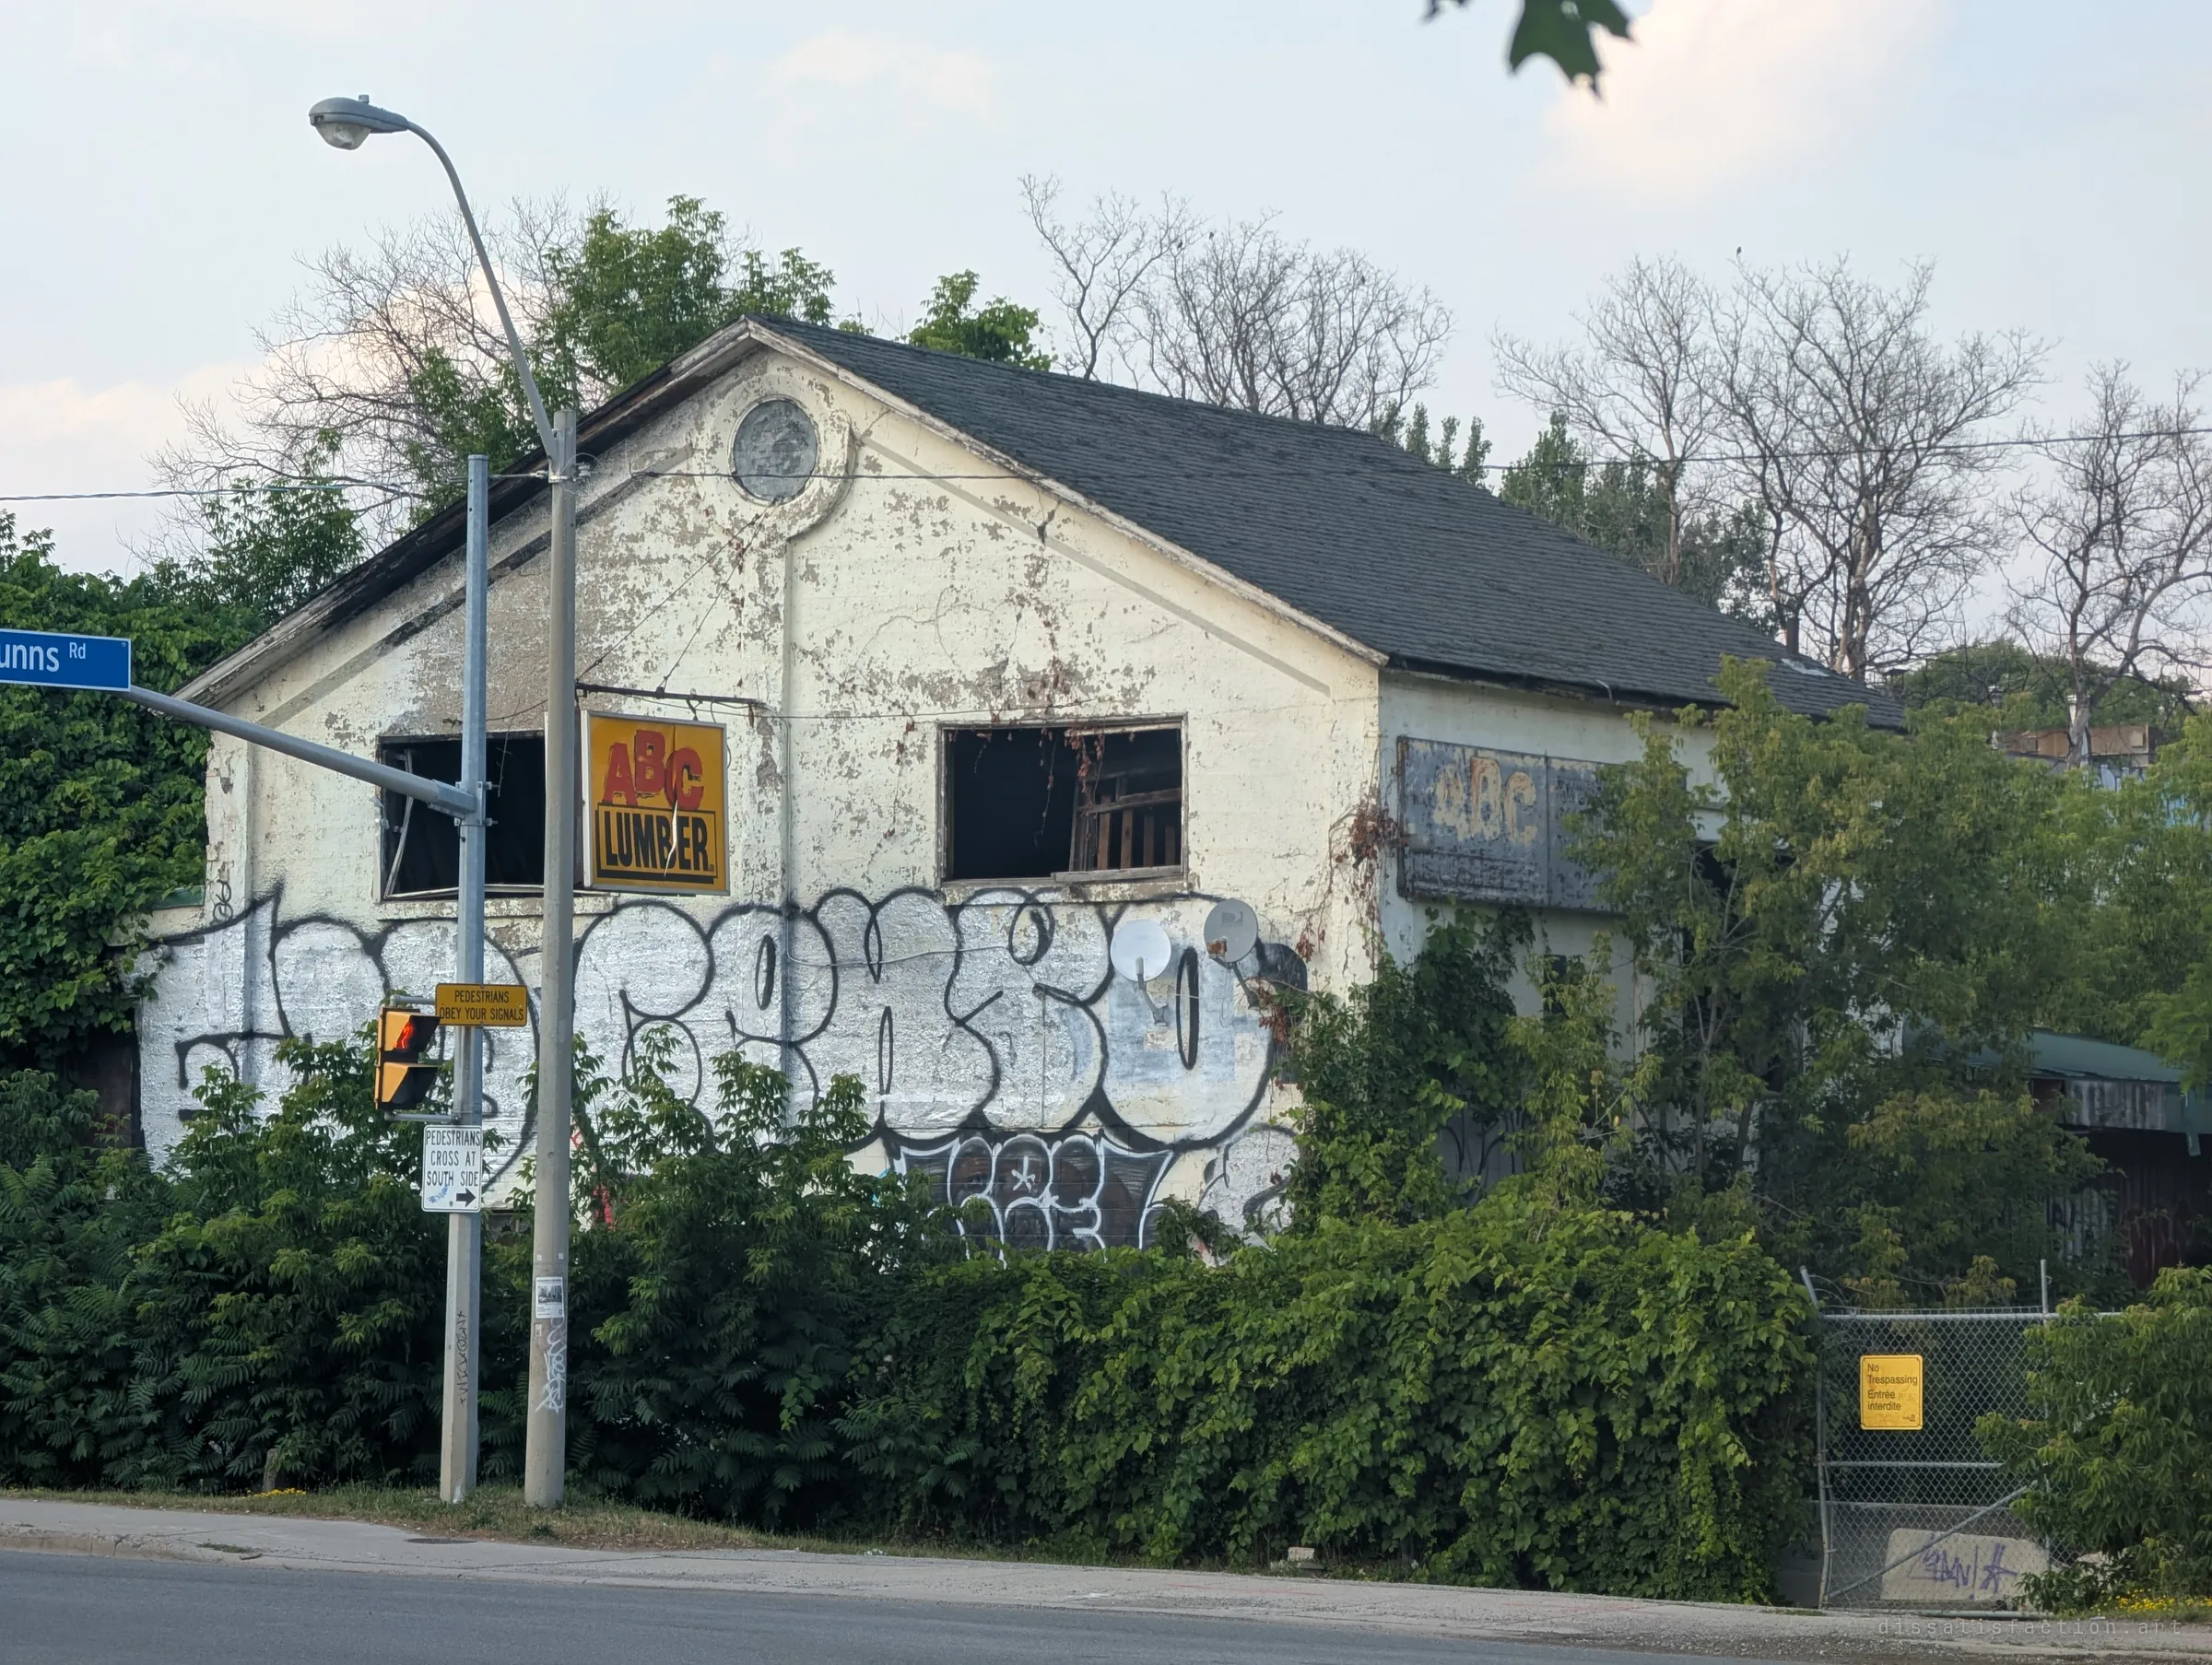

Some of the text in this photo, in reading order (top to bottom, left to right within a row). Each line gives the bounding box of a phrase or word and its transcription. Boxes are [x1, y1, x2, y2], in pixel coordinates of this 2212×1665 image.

[69, 642, 86, 659] Rd
[602, 730, 704, 811] ABC
[604, 811, 709, 872] LUMBER
[454, 990, 509, 1003] PEDESTRIANS
[440, 1006, 524, 1021] OBEY YOUR SIGNALS
[426, 1130, 480, 1146] PEDESTRIANS
[430, 1150, 476, 1167] CROSS AT
[426, 1170, 478, 1187] SOUTH SIDE
[1867, 1364, 1879, 1372] No
[1867, 1375, 1918, 1386] Trespassing
[1867, 1389, 1895, 1399] Entrée
[1867, 1401, 1901, 1411] interdite
